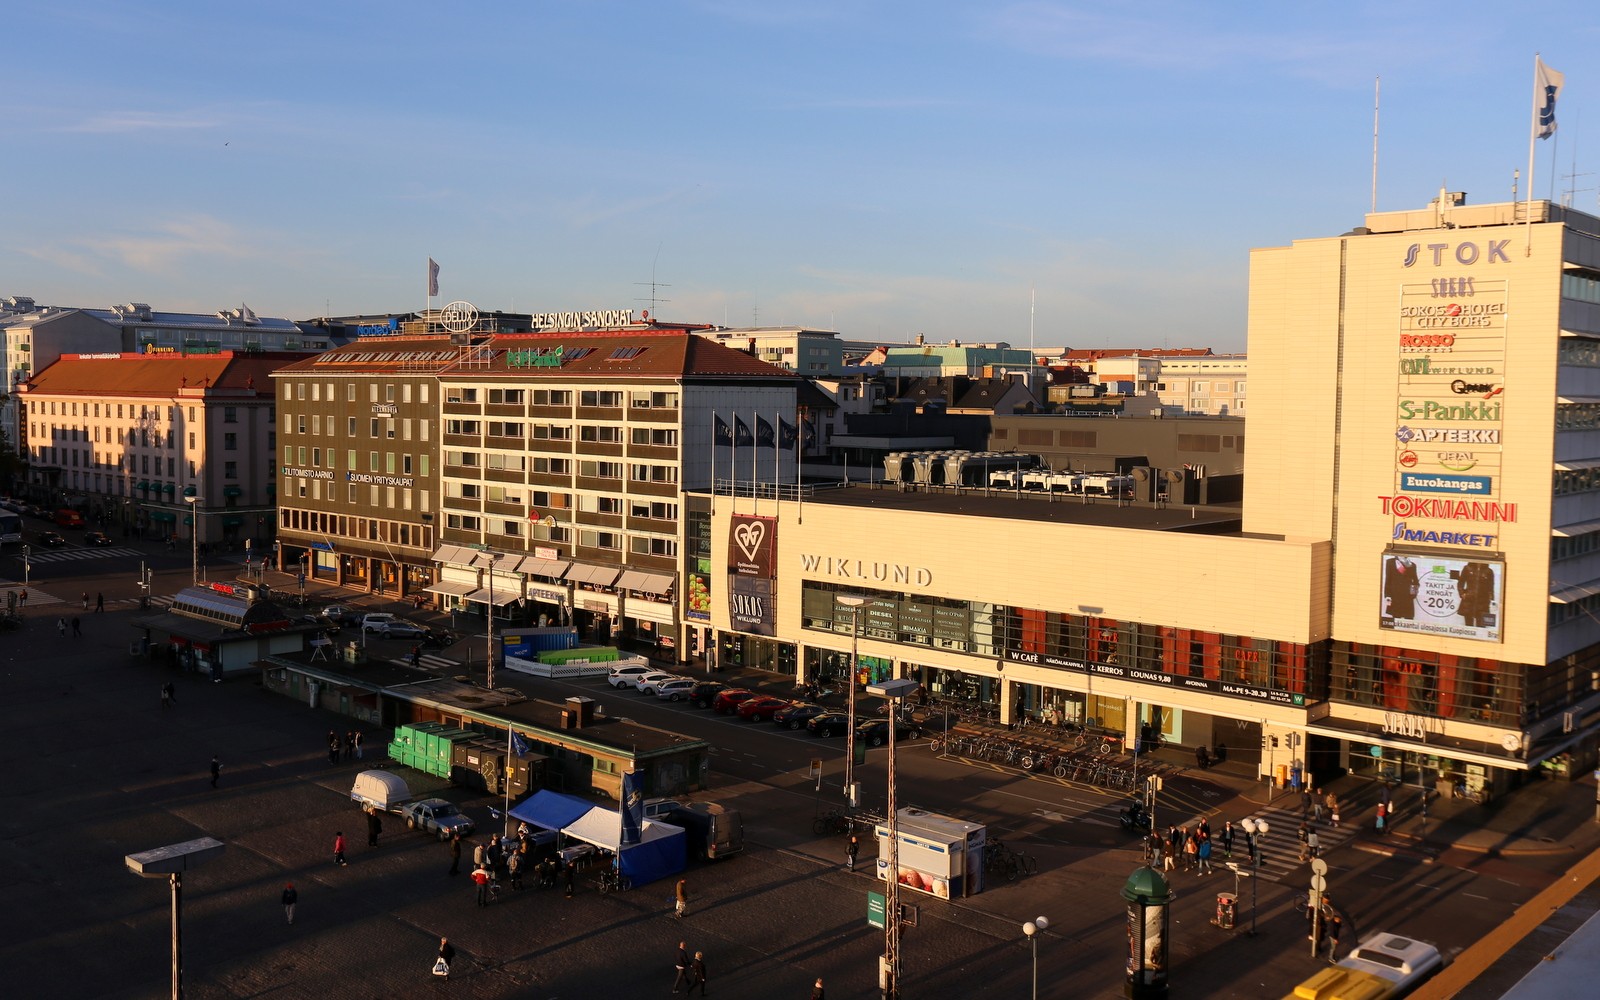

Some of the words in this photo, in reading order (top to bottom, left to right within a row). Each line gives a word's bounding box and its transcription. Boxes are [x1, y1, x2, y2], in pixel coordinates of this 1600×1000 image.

[1431, 277, 1475, 298] SOKOS
[1401, 306, 1445, 317] SOKOS
[1461, 303, 1505, 316] HOTEL
[446, 311, 472, 323] DELUX
[531, 312, 581, 328] HELSINGIN
[582, 309, 633, 327] SANOMAT
[1418, 317, 1448, 328] CITY
[357, 324, 388, 335] Nordea
[1400, 334, 1455, 347] ROSSO
[506, 352, 529, 367] POP
[1399, 399, 1501, 421] S-Pankki
[1411, 428, 1499, 444] APTEEKKI
[315, 470, 334, 479] AARNIO
[350, 473, 373, 483] SUOMEN
[373, 475, 413, 487] YRITYSKAUPAT
[1407, 477, 1483, 491] Eurokangas
[1377, 495, 1517, 523] TOKMANNI
[801, 554, 932, 587] WIKLUND
[733, 594, 762, 617] SOKOS
[1423, 597, 1455, 610] -20%
[737, 615, 761, 624] WIKLUND
[870, 610, 893, 618] DIESEL
[1420, 624, 1448, 634] ulosajossa
[1097, 666, 1123, 676] KERROS
[1130, 671, 1157, 681] LOUNAS
[1158, 675, 1171, 683] 9,80
[1185, 680, 1207, 688] AVOINNA
[1236, 720, 1248, 730] W
[1382, 712, 1423, 738] SOKOS
